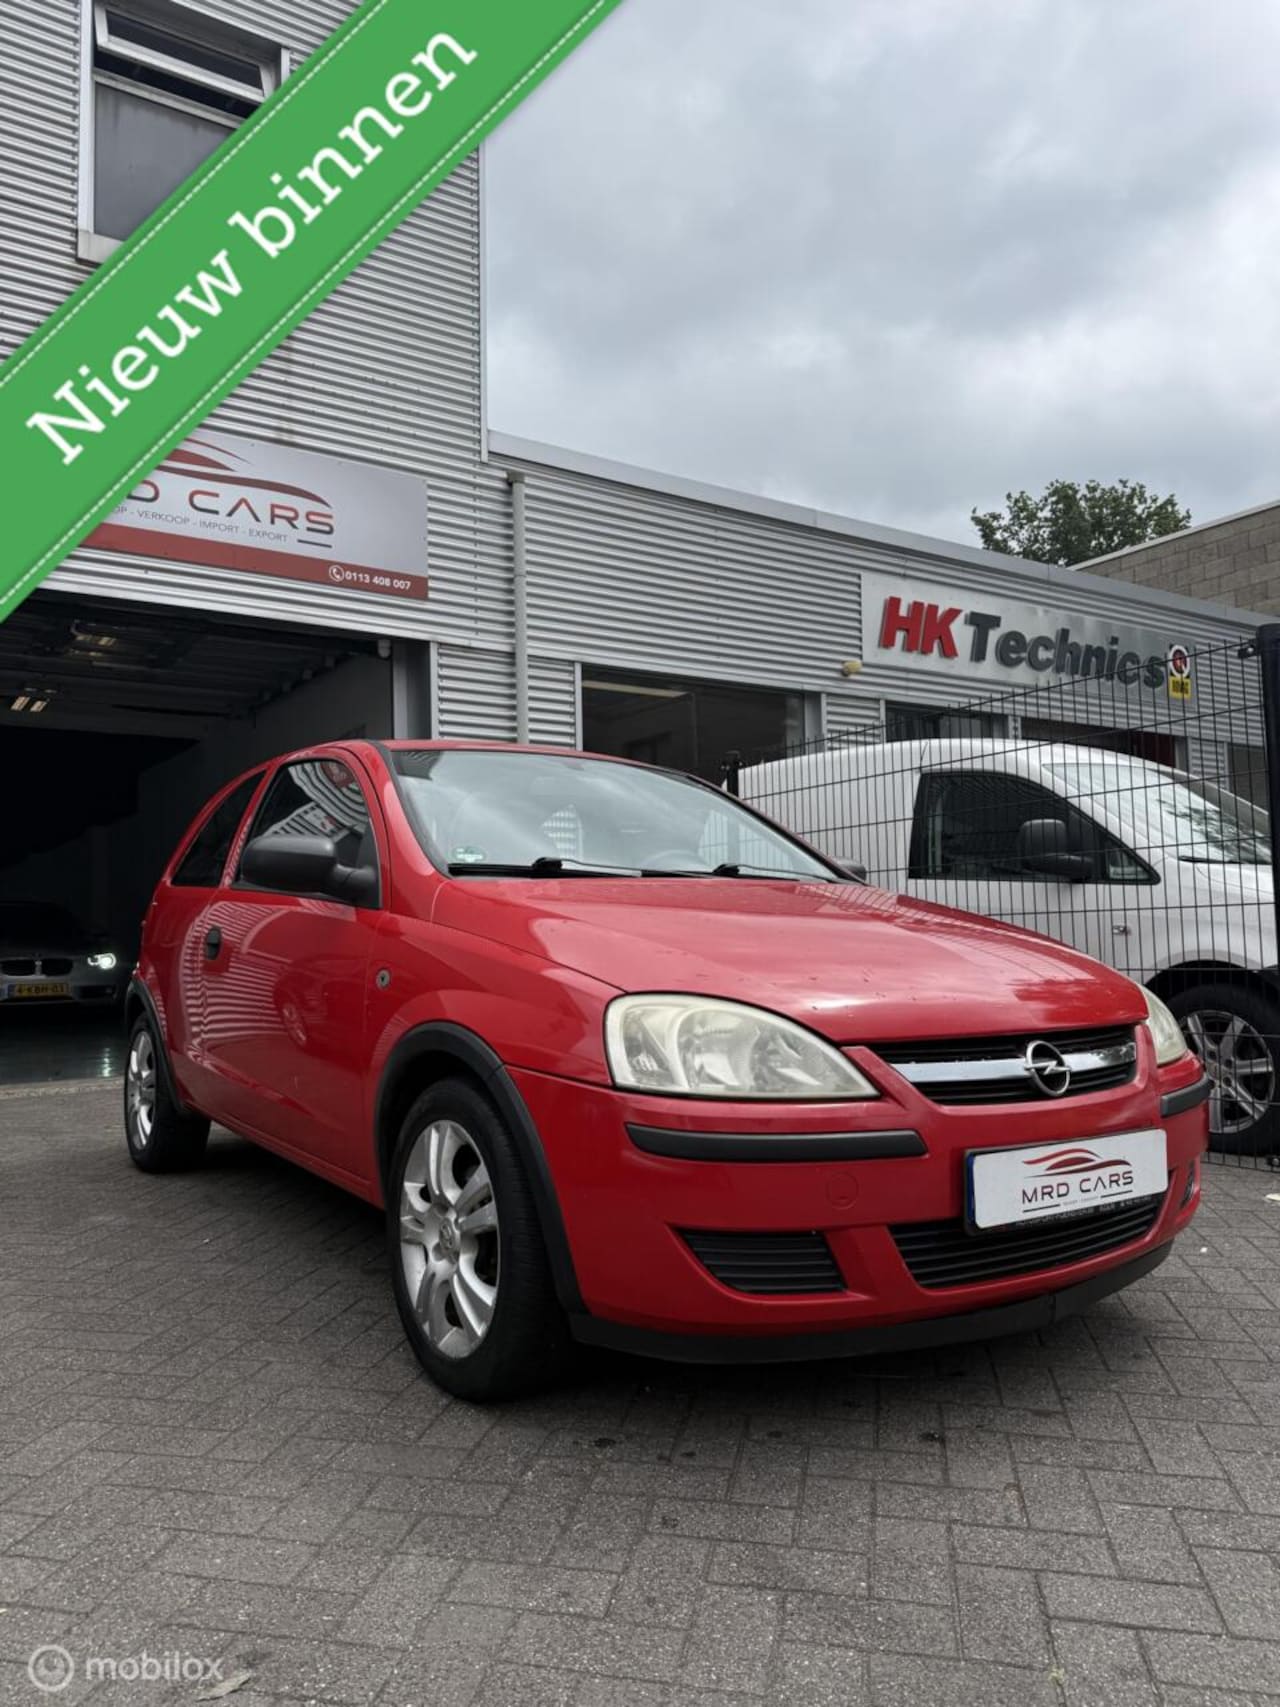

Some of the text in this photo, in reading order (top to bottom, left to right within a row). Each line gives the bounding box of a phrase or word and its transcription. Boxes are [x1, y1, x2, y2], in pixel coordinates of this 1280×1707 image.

[137, 509, 190, 525] VERKOOP
[199, 519, 240, 535] IMPORT
[248, 528, 288, 544] EXPORT
[188, 489, 335, 535] CARS
[344, 570, 370, 585] 0113
[392, 578, 412, 592] 007
[1021, 1182, 1070, 1204] MRD
[1079, 1170, 1134, 1194] CARS
